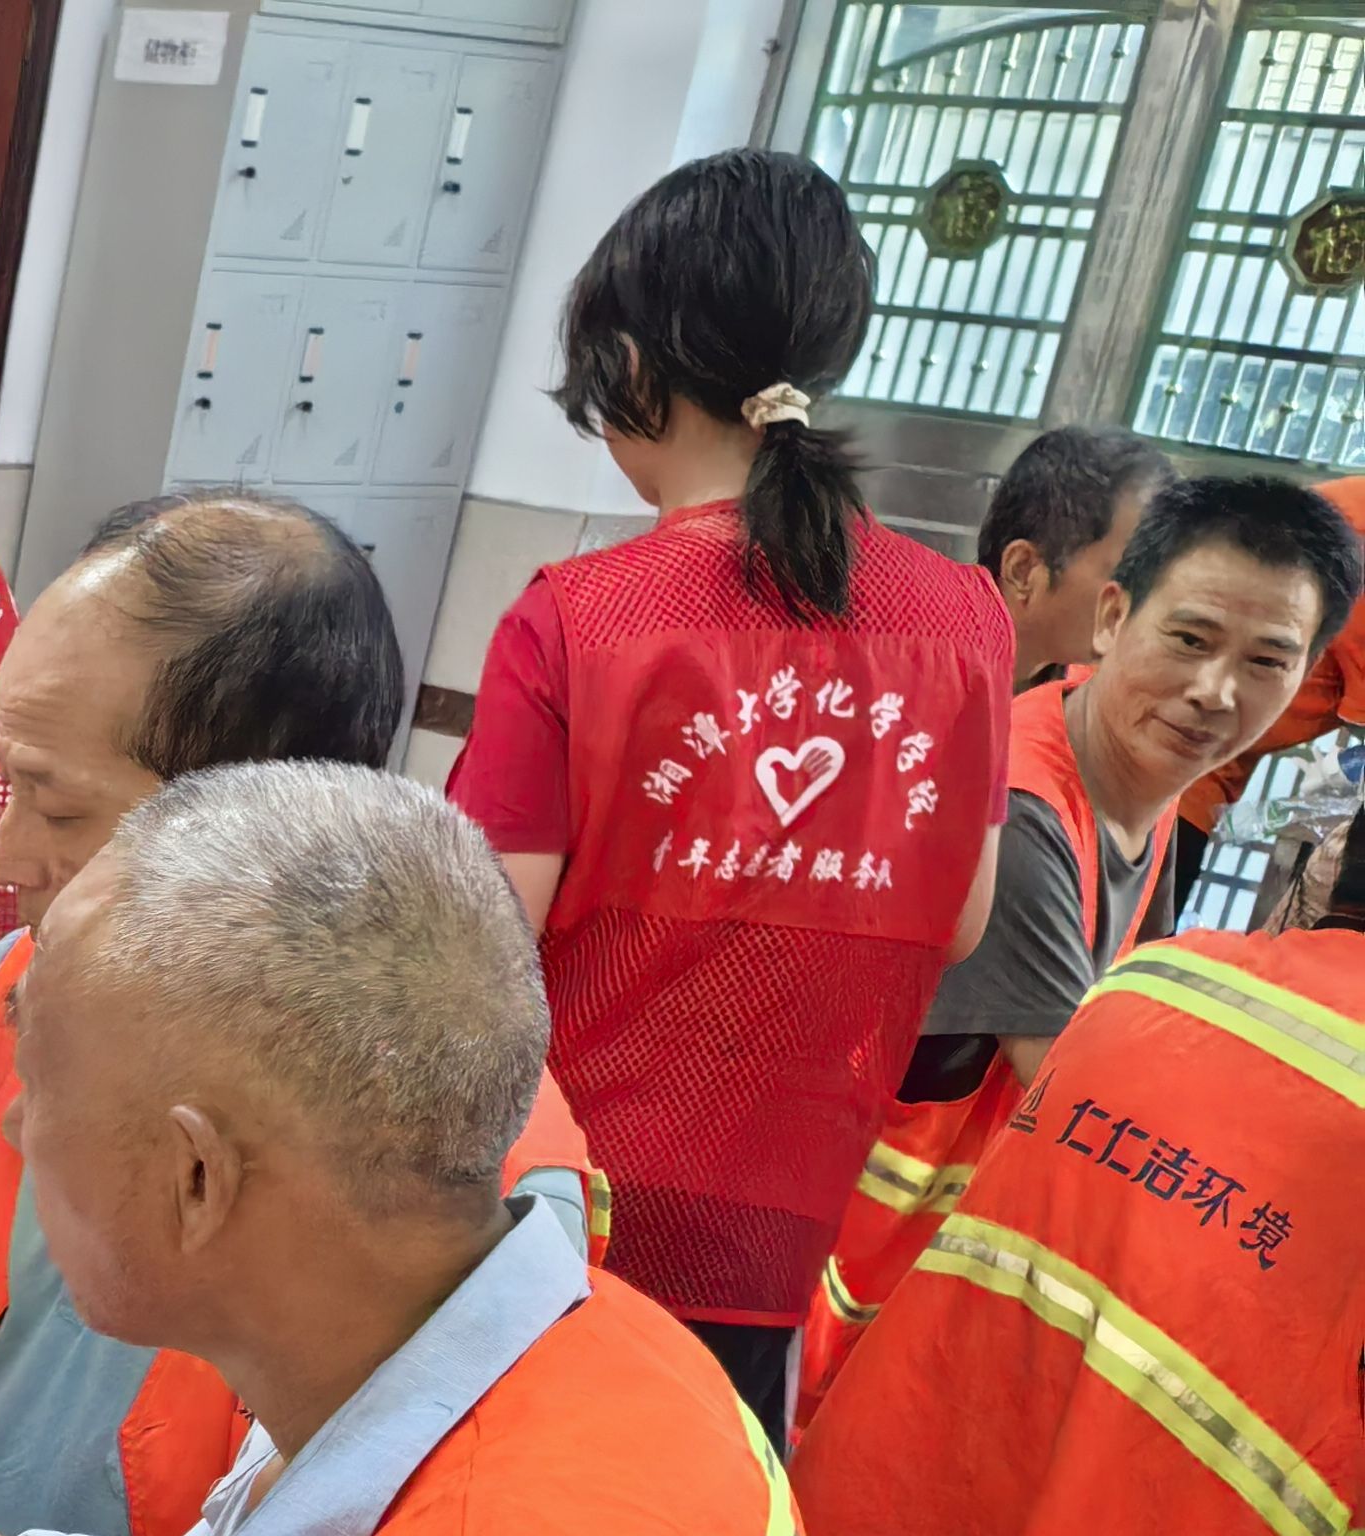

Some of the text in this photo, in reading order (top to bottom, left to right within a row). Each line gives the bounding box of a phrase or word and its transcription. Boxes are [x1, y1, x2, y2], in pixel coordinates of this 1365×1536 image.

[1055, 1098, 1299, 1271] 仁仁洁环境
